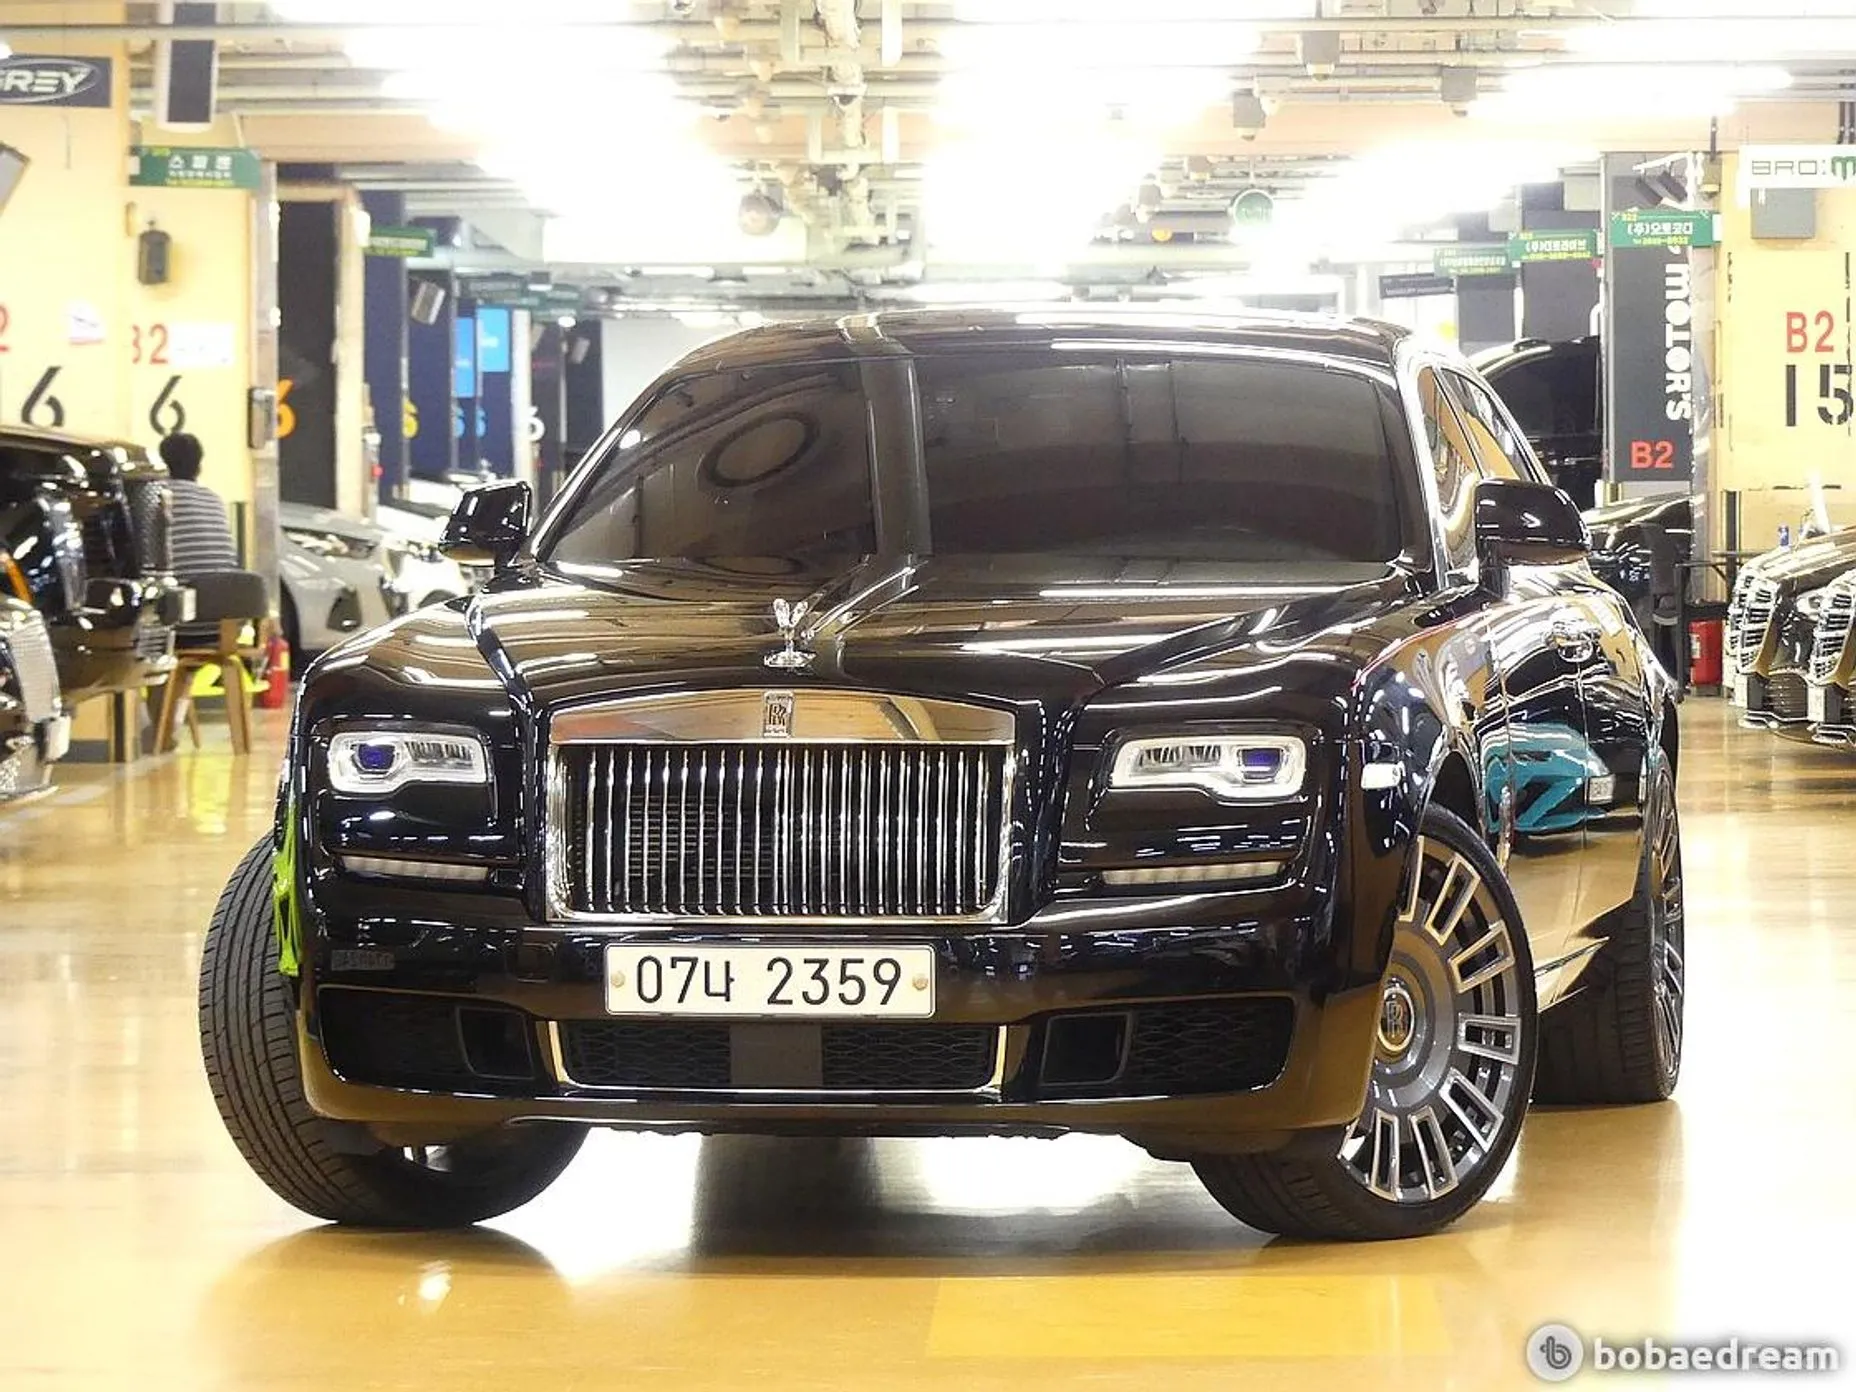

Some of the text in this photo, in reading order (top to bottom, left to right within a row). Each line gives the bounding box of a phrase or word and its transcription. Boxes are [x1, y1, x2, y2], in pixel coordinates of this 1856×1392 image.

[1786, 310, 1834, 353] B2
[149, 375, 186, 436] 6
[1785, 364, 1853, 427] 15
[1631, 441, 1674, 469] B2
[636, 955, 902, 1006] 07나 2359
